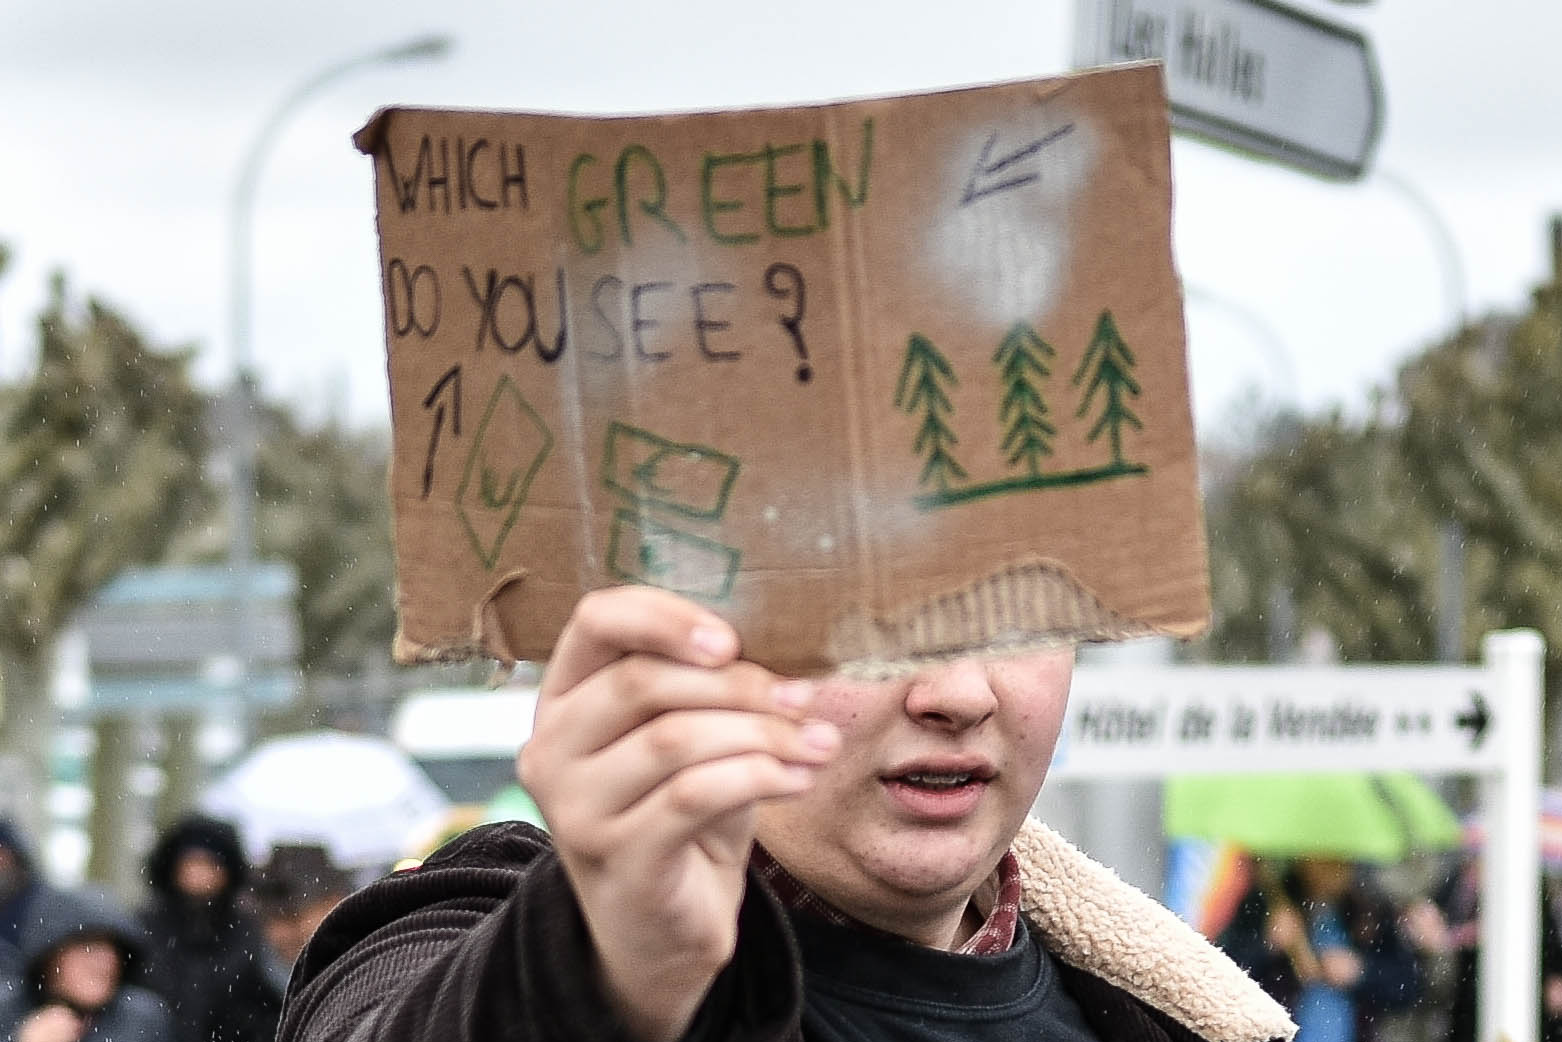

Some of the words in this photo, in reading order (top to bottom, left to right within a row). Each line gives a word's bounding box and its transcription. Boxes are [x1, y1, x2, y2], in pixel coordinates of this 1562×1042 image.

[385, 133, 529, 215] WHICH
[568, 116, 876, 254] GREEN
[388, 257, 441, 338] DO
[462, 266, 567, 363] YOU
[1178, 696, 1218, 742] de
[1231, 696, 1256, 741] la
